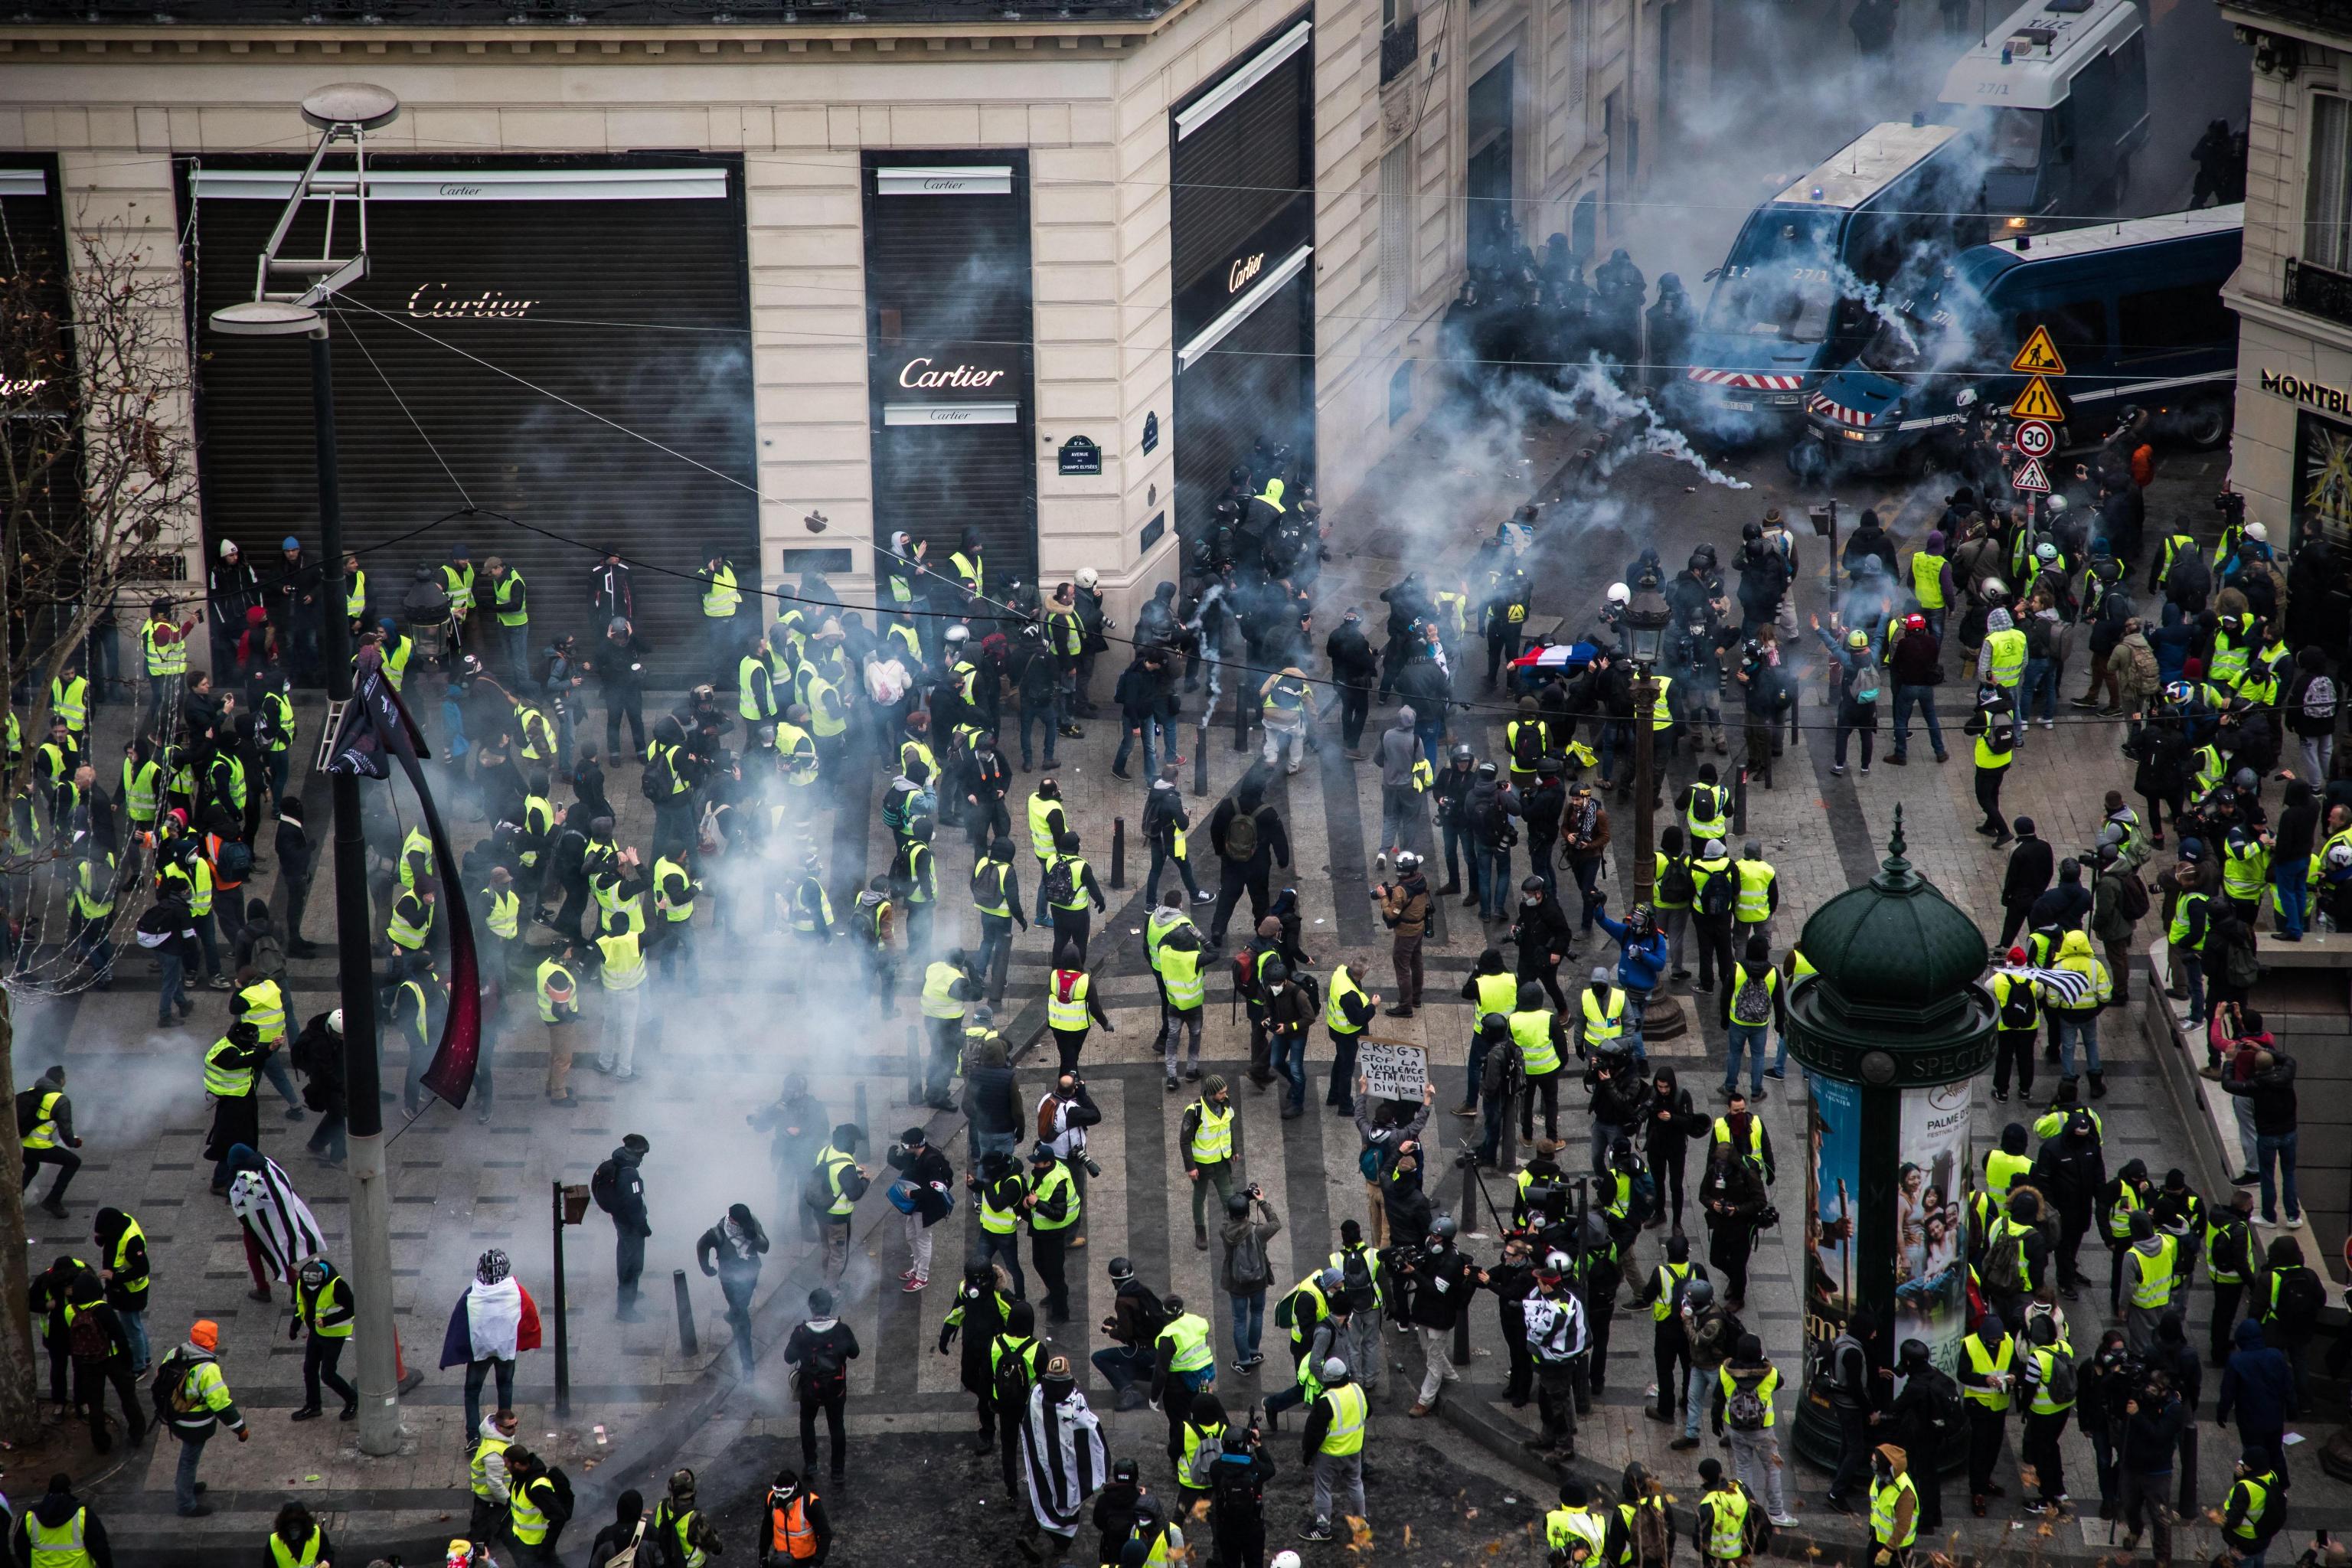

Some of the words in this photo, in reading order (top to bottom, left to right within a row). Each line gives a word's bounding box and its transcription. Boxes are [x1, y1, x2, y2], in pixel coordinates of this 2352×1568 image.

[1977, 83, 2010, 95] 27/1
[439, 183, 482, 196] Cartier
[923, 177, 965, 190] Cartier
[1229, 252, 1264, 293] Cartier
[1793, 268, 1828, 282] 27/1
[407, 283, 541, 318] Cartier
[899, 358, 1004, 388] Cartier
[929, 409, 972, 420] Cartier
[1945, 413, 1962, 423] GEN
[2024, 430, 2047, 448] 30
[1023, 624, 1040, 637] TV
[2335, 854, 2350, 863] TV
[1361, 1041, 1392, 1054] CRS
[1396, 1047, 1420, 1058] GJ
[1361, 1054, 1393, 1063] STOP
[1399, 1073, 1425, 1083] NOUS
[1927, 1112, 1959, 1130] PALME
